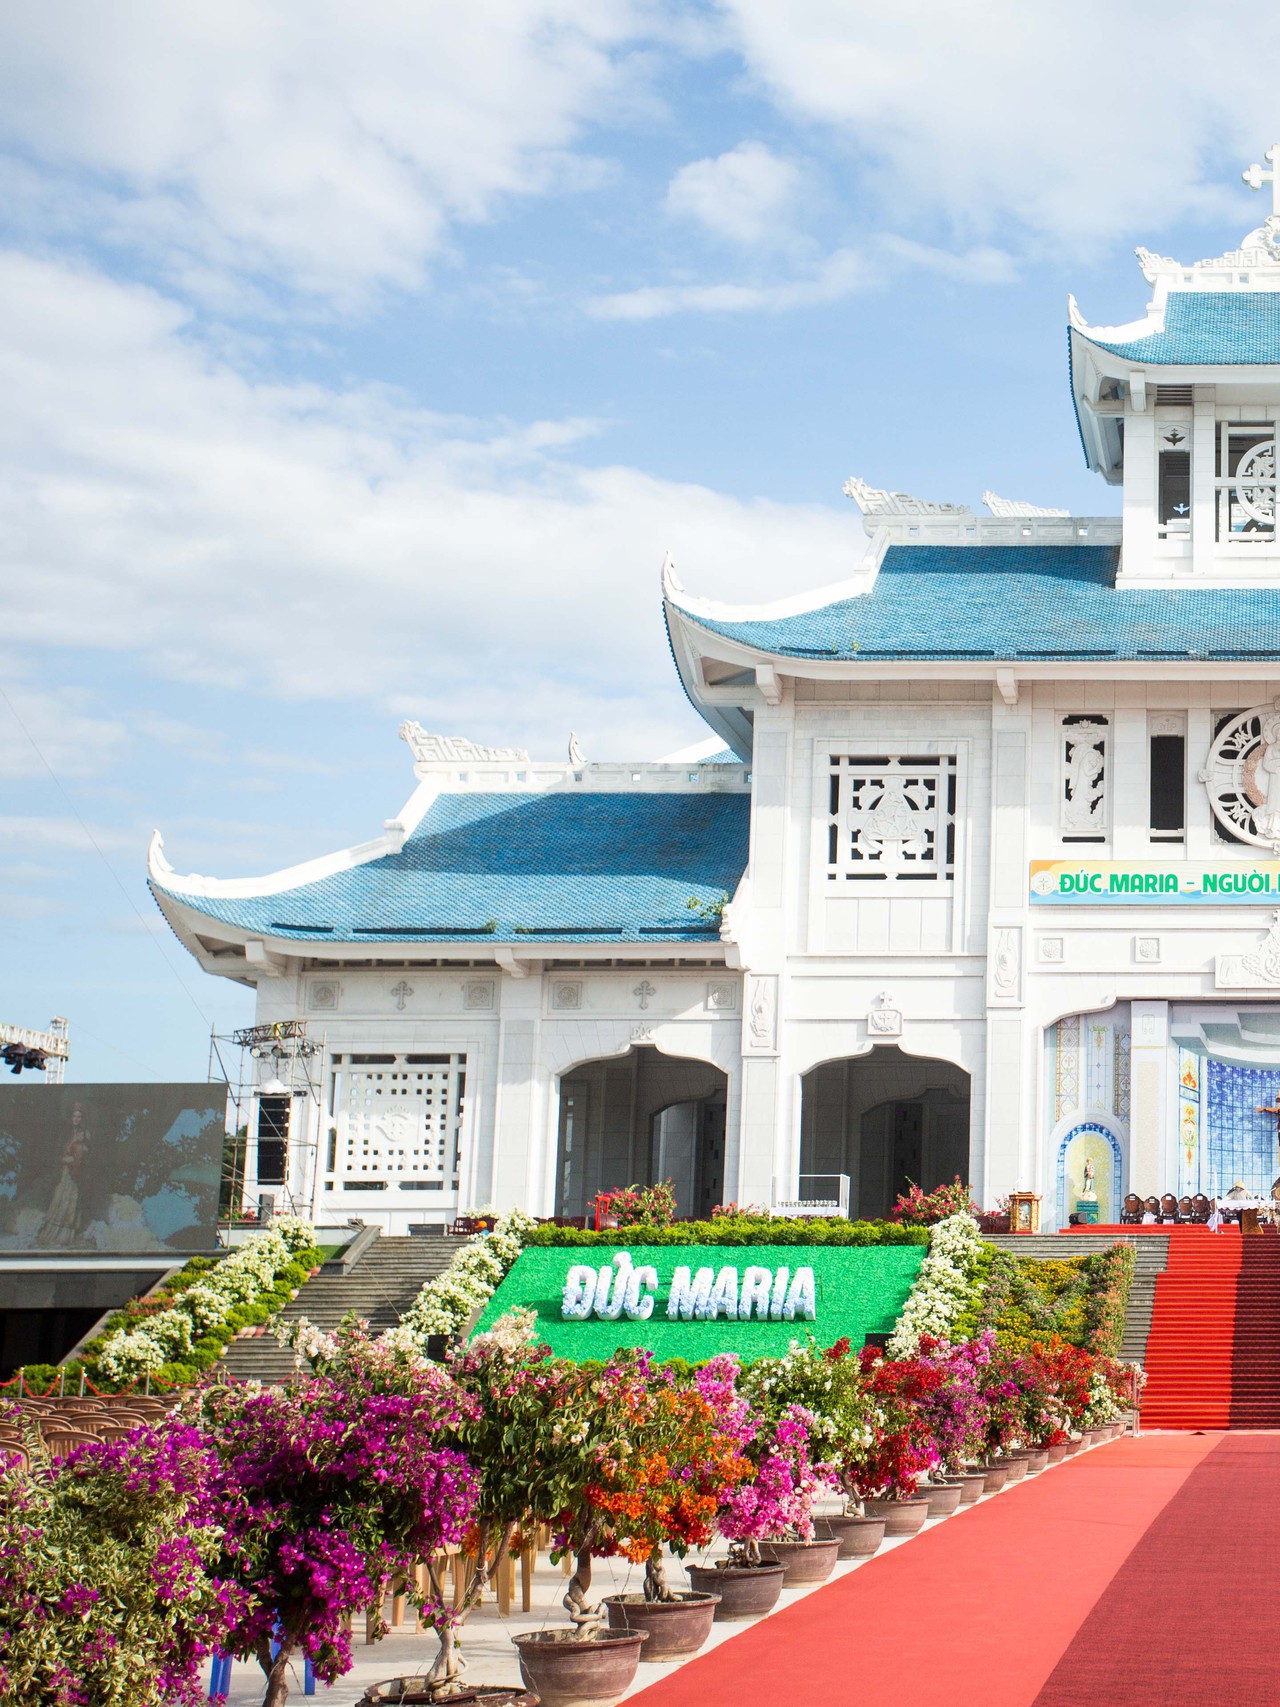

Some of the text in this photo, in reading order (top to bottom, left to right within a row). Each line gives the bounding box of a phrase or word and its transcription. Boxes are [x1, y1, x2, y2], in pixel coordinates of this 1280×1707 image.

[1059, 869, 1102, 893] ĐỨC
[1109, 873, 1178, 893] MARIA
[1202, 869, 1270, 893] NGƯỜI
[561, 1251, 816, 1321] ĐỨC MARIA
